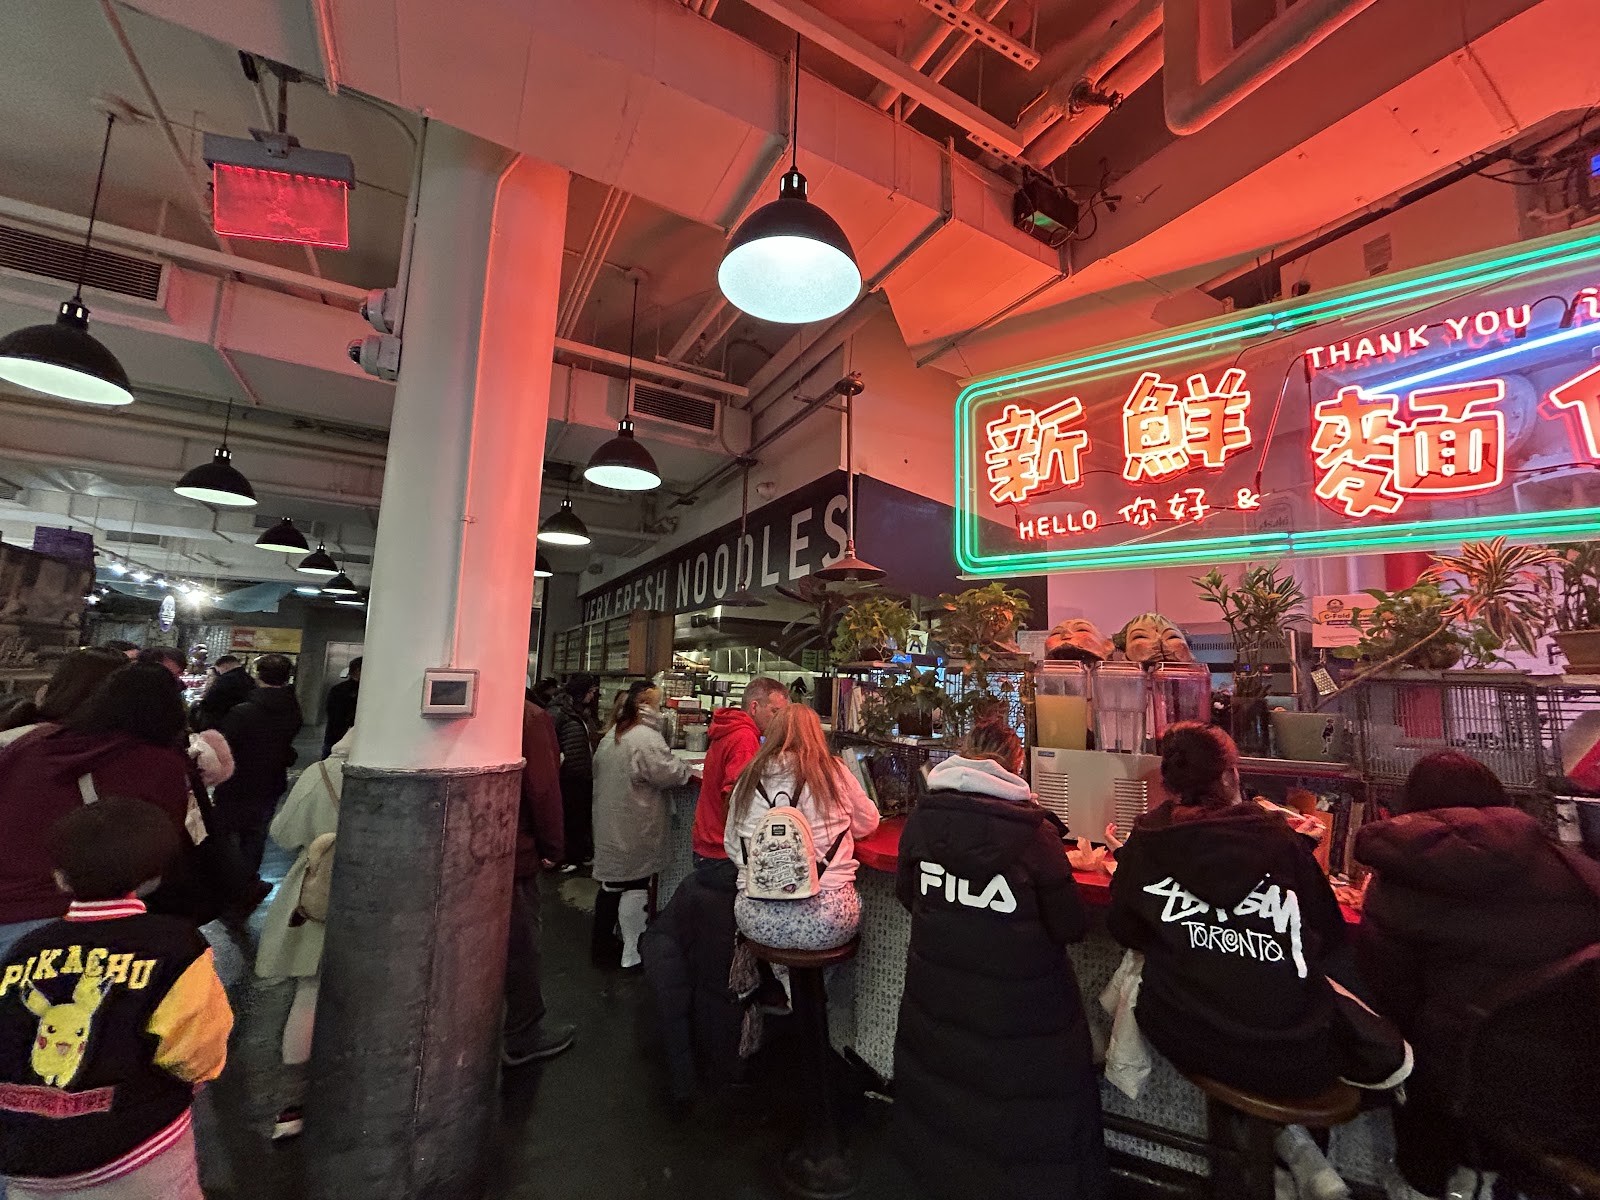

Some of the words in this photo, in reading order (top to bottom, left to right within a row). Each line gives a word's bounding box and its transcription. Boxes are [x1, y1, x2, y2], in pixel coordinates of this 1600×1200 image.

[1305, 324, 1430, 368] THANK
[1446, 304, 1532, 340] YOU
[1019, 509, 1097, 539] HELLO
[1117, 488, 1210, 526] 你好
[1237, 487, 1261, 509] &
[615, 569, 667, 613] FRESH
[676, 494, 848, 609] NOODLES
[919, 860, 1018, 914] FILA
[1181, 920, 1285, 962] TORONTO
[0, 944, 157, 996] PIKACHU
